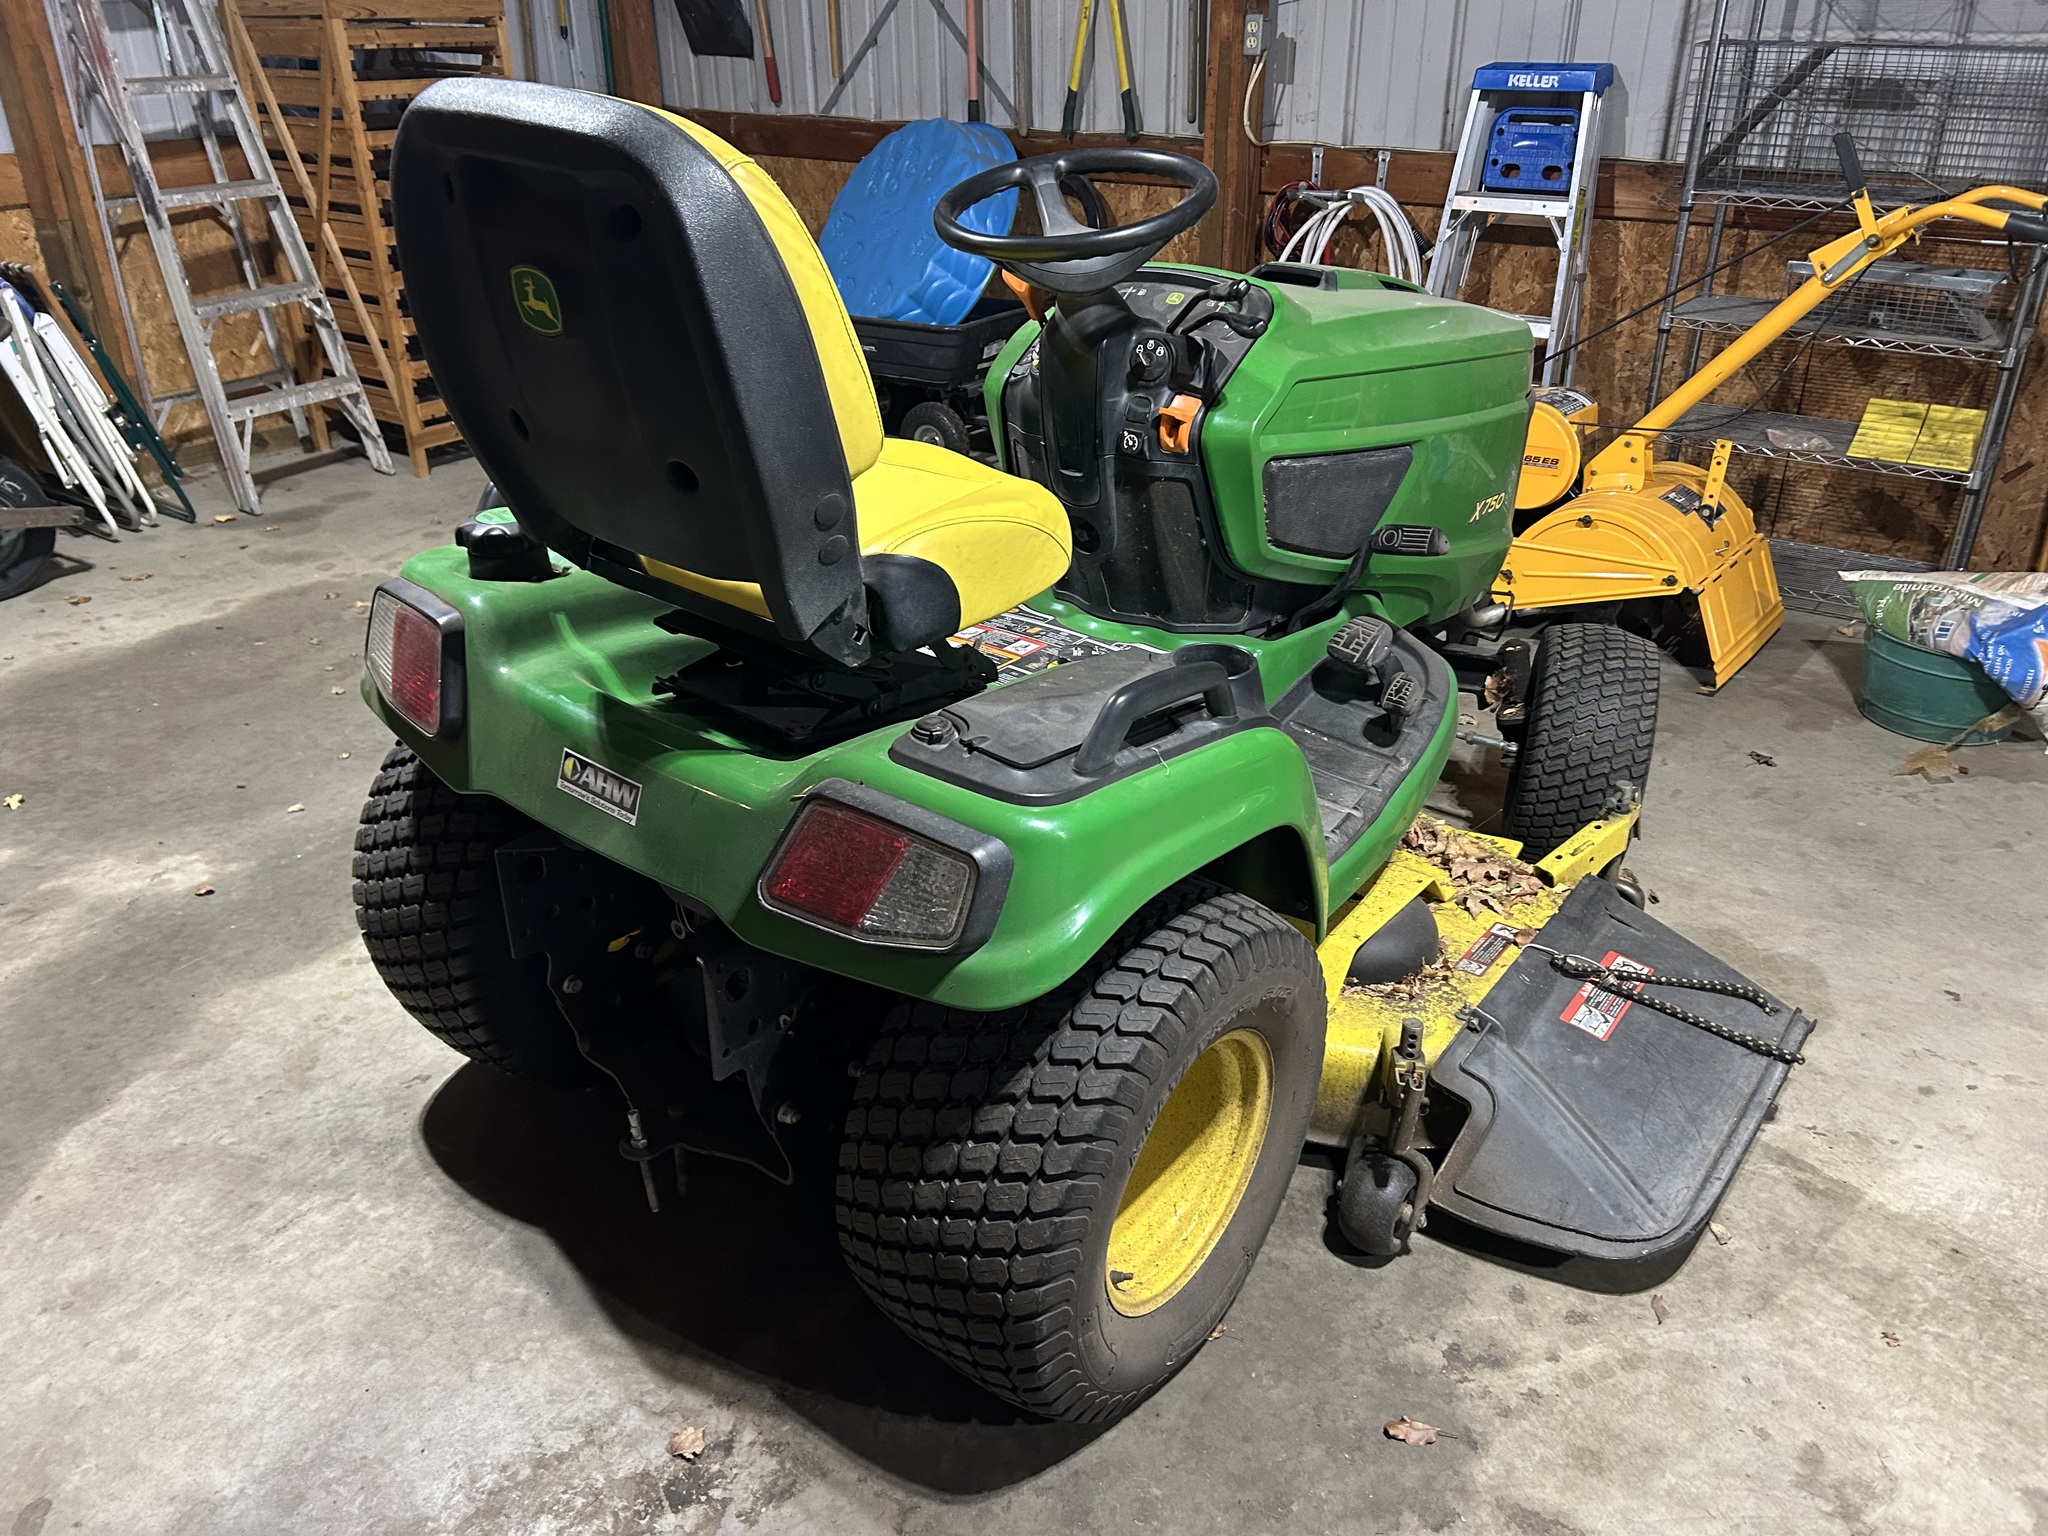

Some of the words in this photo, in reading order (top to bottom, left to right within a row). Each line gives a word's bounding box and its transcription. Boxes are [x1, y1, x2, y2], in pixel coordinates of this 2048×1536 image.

[1508, 74, 1559, 88] KELLER
[1469, 492, 1505, 523] X750
[1892, 583, 1984, 608] Milorganite
[560, 780, 591, 802] Tomorrow's
[590, 796, 616, 815] Solutions
[616, 808, 634, 824] Today
[578, 766, 638, 809] AHW
